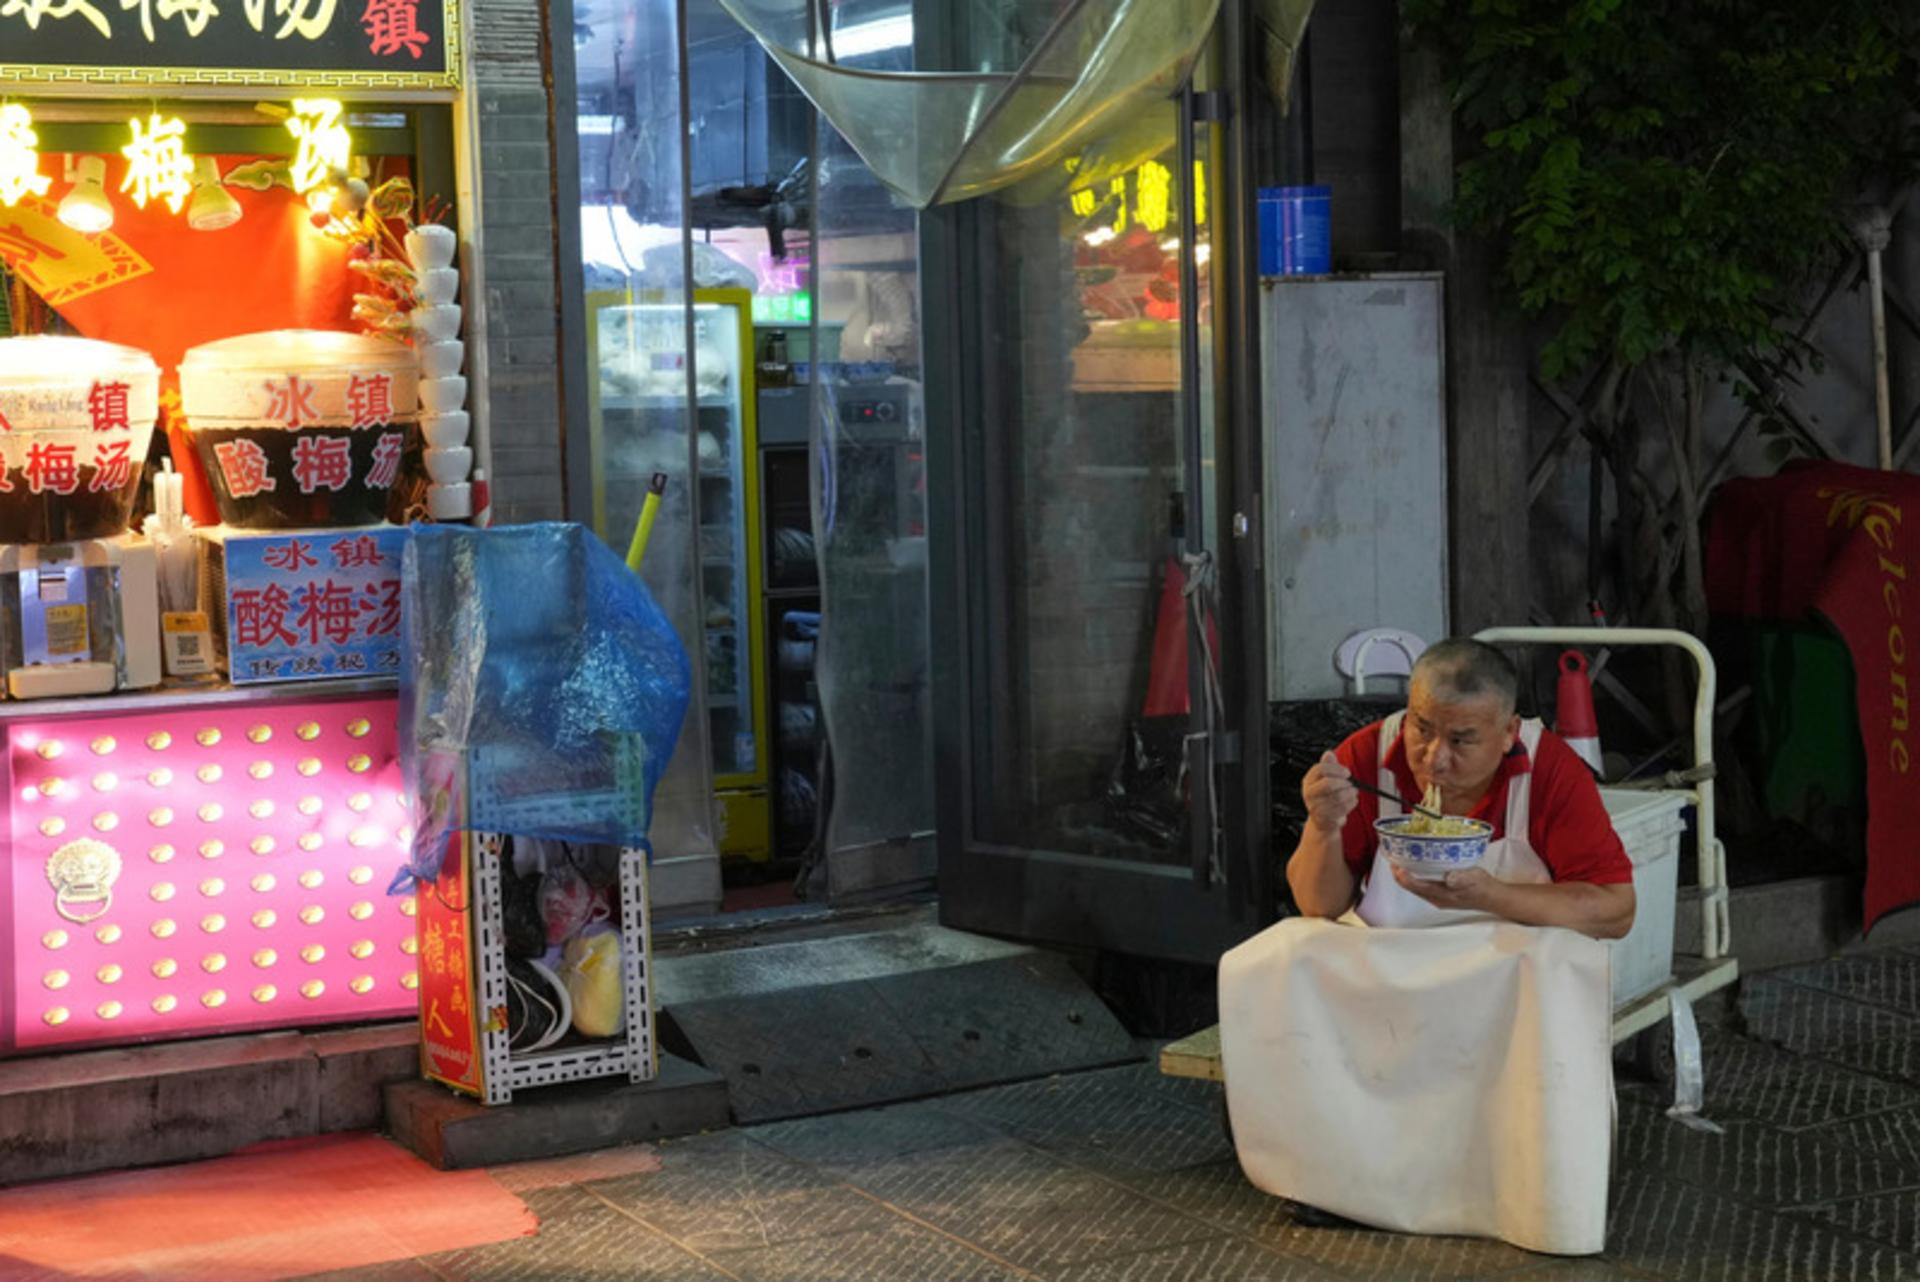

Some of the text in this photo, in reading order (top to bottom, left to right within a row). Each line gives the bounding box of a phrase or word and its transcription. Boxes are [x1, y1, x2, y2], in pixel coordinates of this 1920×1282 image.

[0, 381, 130, 432] 镇
[262, 374, 393, 431] 冰镇
[214, 434, 403, 498] 酸梅汤
[263, 535, 385, 571] 冰镇
[231, 579, 401, 647] 酸梅汤
